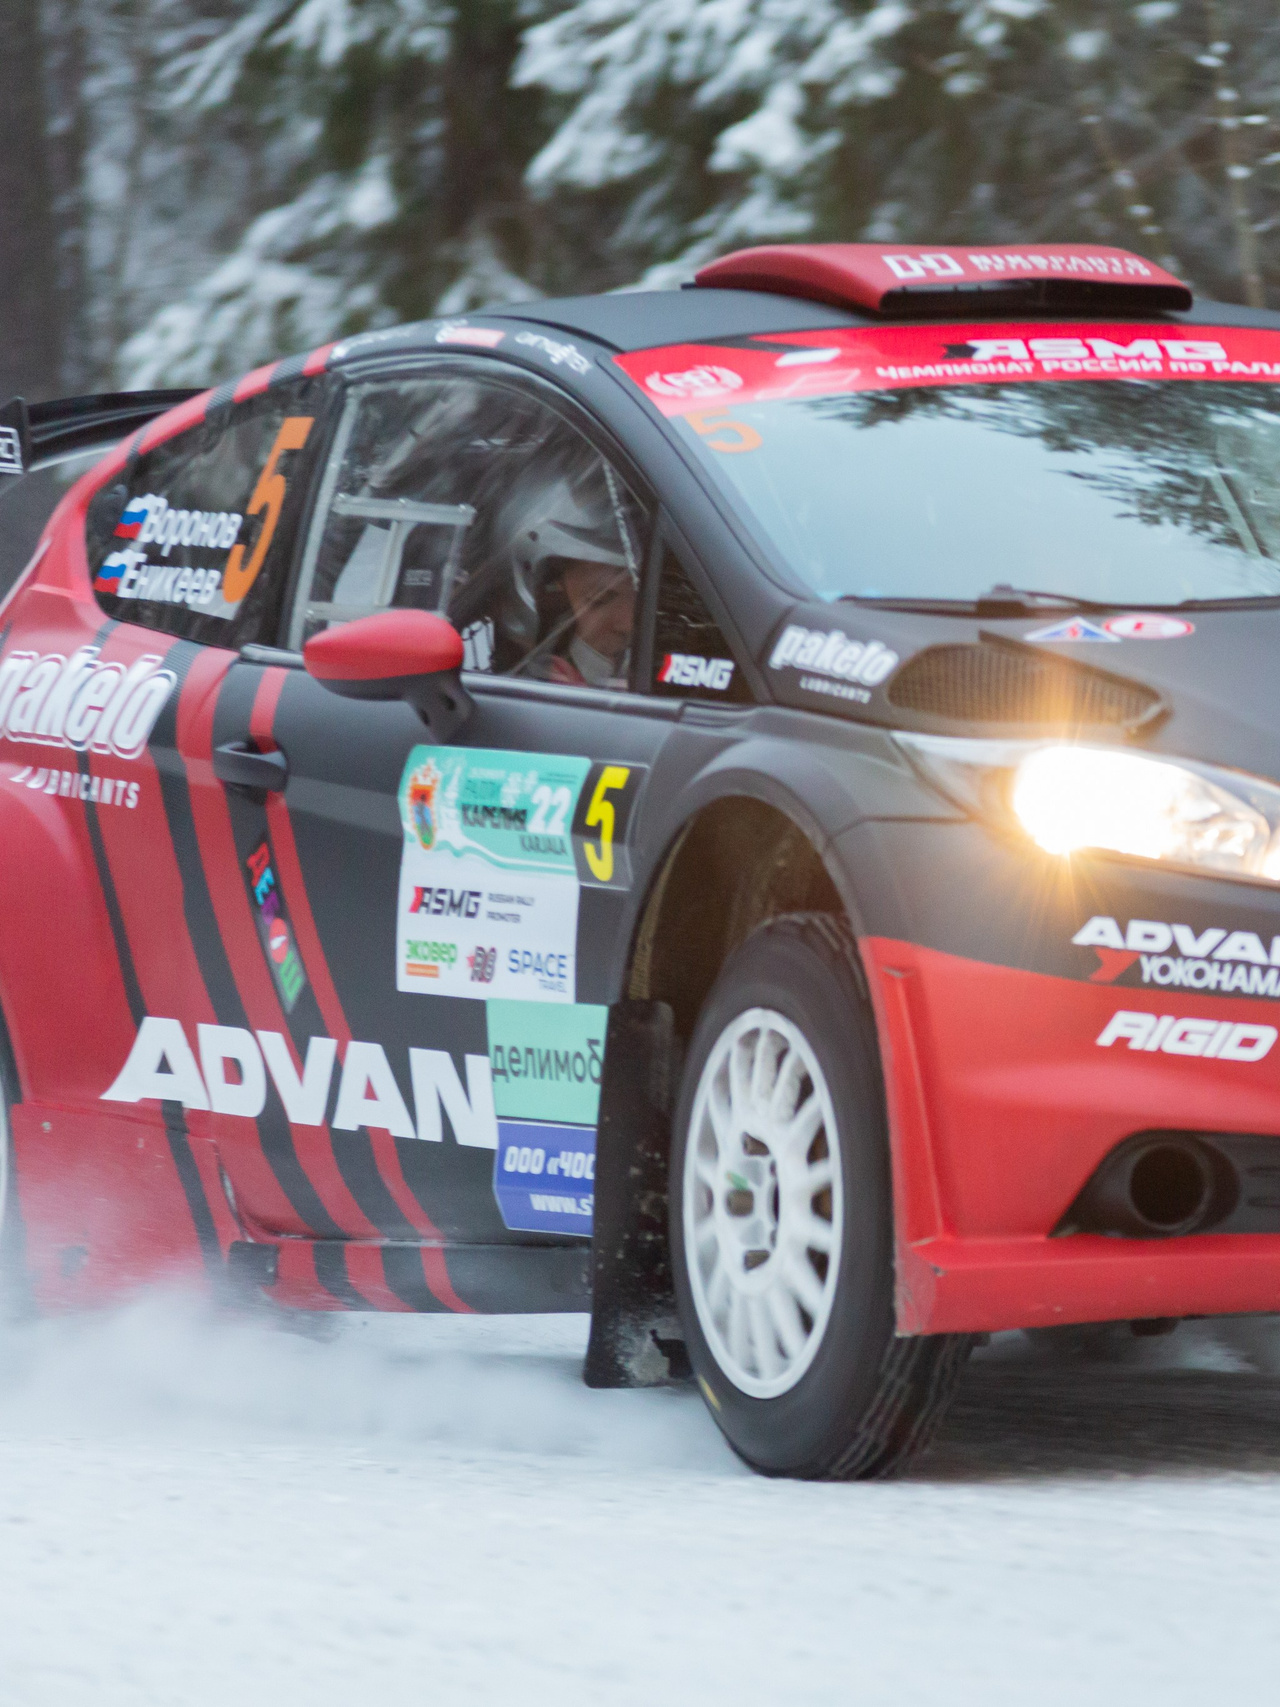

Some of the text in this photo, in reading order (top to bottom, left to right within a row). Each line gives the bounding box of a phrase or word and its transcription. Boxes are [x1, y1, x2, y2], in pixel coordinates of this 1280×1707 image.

[875, 361, 1035, 381] ЧЕМПИОНАТ
[1042, 358, 1164, 375] РОССИИ
[967, 338, 1228, 361] ASMG
[682, 405, 764, 454] 5
[137, 495, 243, 557] Воронов
[222, 416, 315, 603] 5
[117, 552, 222, 604] Еникеев
[664, 654, 735, 690] ASMG
[9, 766, 140, 809] LUBRICANTS
[526, 785, 572, 836] 22
[583, 765, 631, 882] 5
[414, 886, 483, 919] ASMG
[508, 949, 568, 979] SPACE
[1096, 1010, 1278, 1062] RIGID
[101, 1016, 498, 1150] ADVAN
[529, 1193, 594, 1218] www.s
